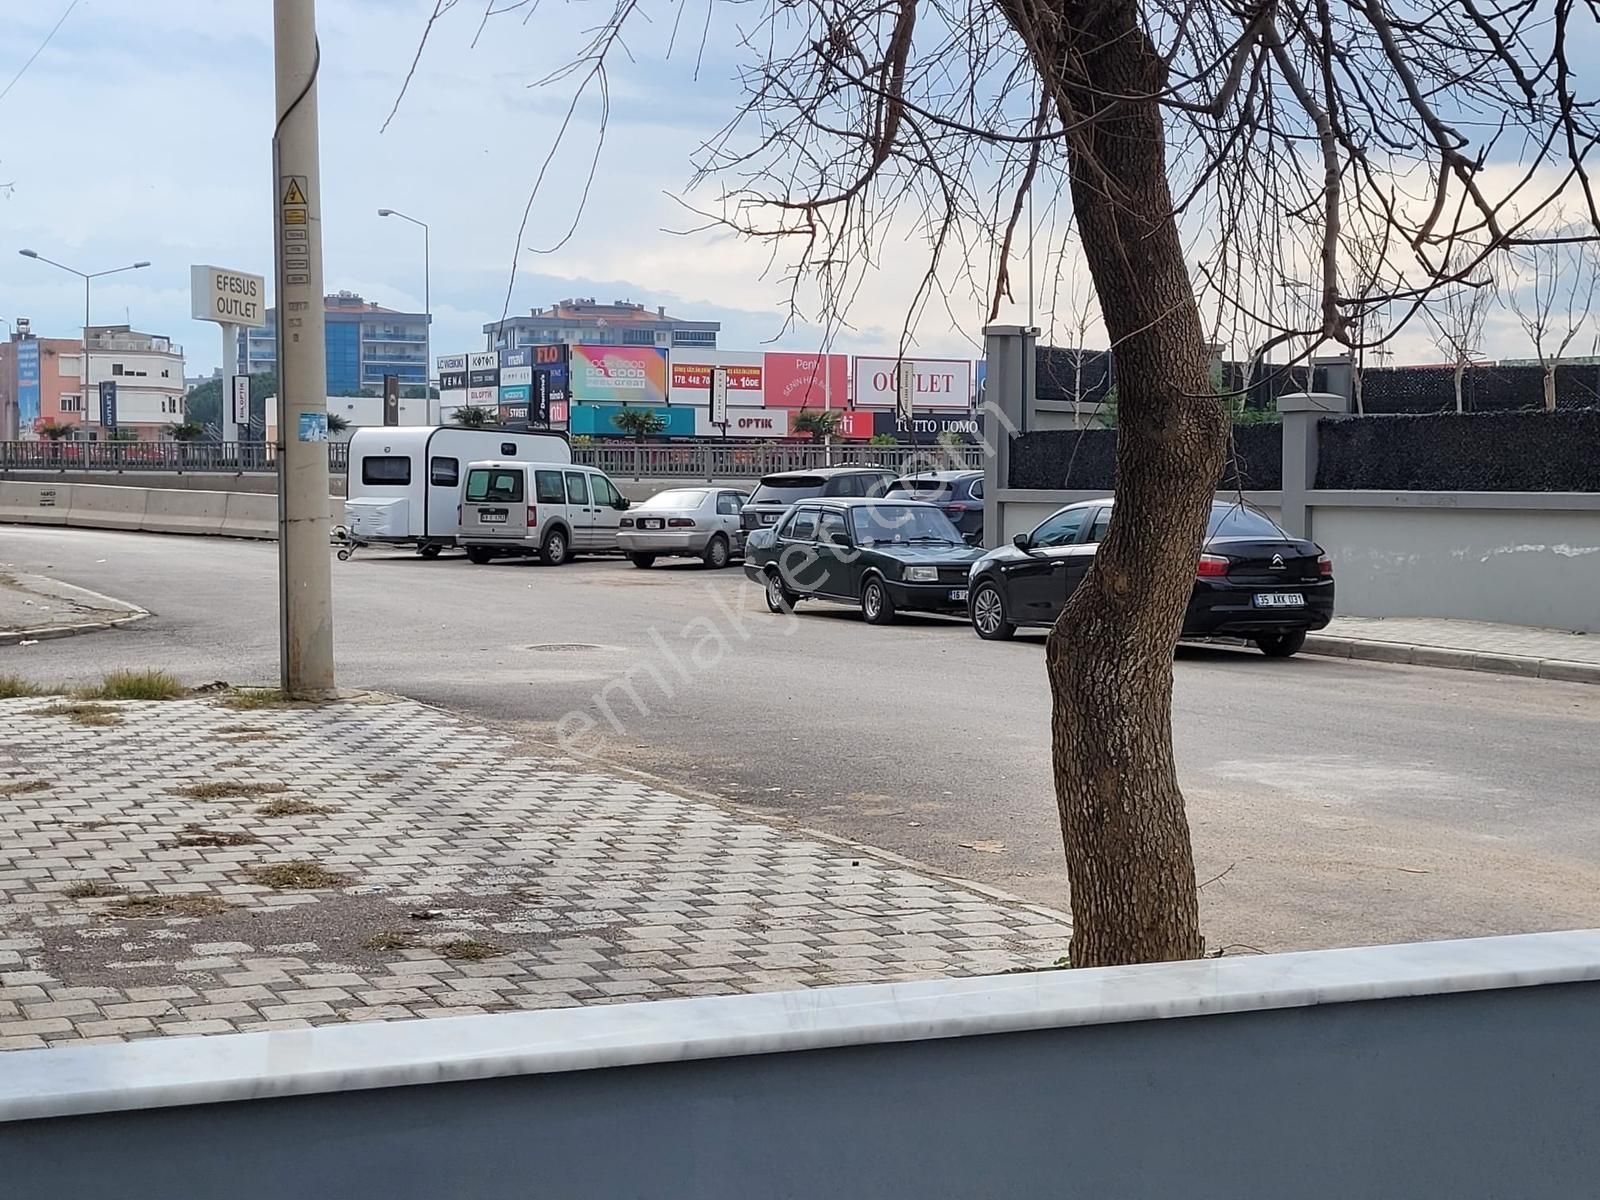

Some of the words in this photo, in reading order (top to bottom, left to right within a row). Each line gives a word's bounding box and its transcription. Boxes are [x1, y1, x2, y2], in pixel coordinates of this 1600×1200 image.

[216, 274, 257, 297] EFESUS
[216, 296, 257, 319] OUTLET
[472, 356, 495, 367] KOTON
[536, 346, 558, 364] FLO
[585, 367, 605, 377] DO
[608, 368, 646, 378] GOOD
[873, 371, 953, 393] OULET
[509, 407, 529, 418] STREET
[942, 420, 979, 434] UOMO
[1259, 595, 1270, 604] 35
[1273, 595, 1287, 604] AKK
